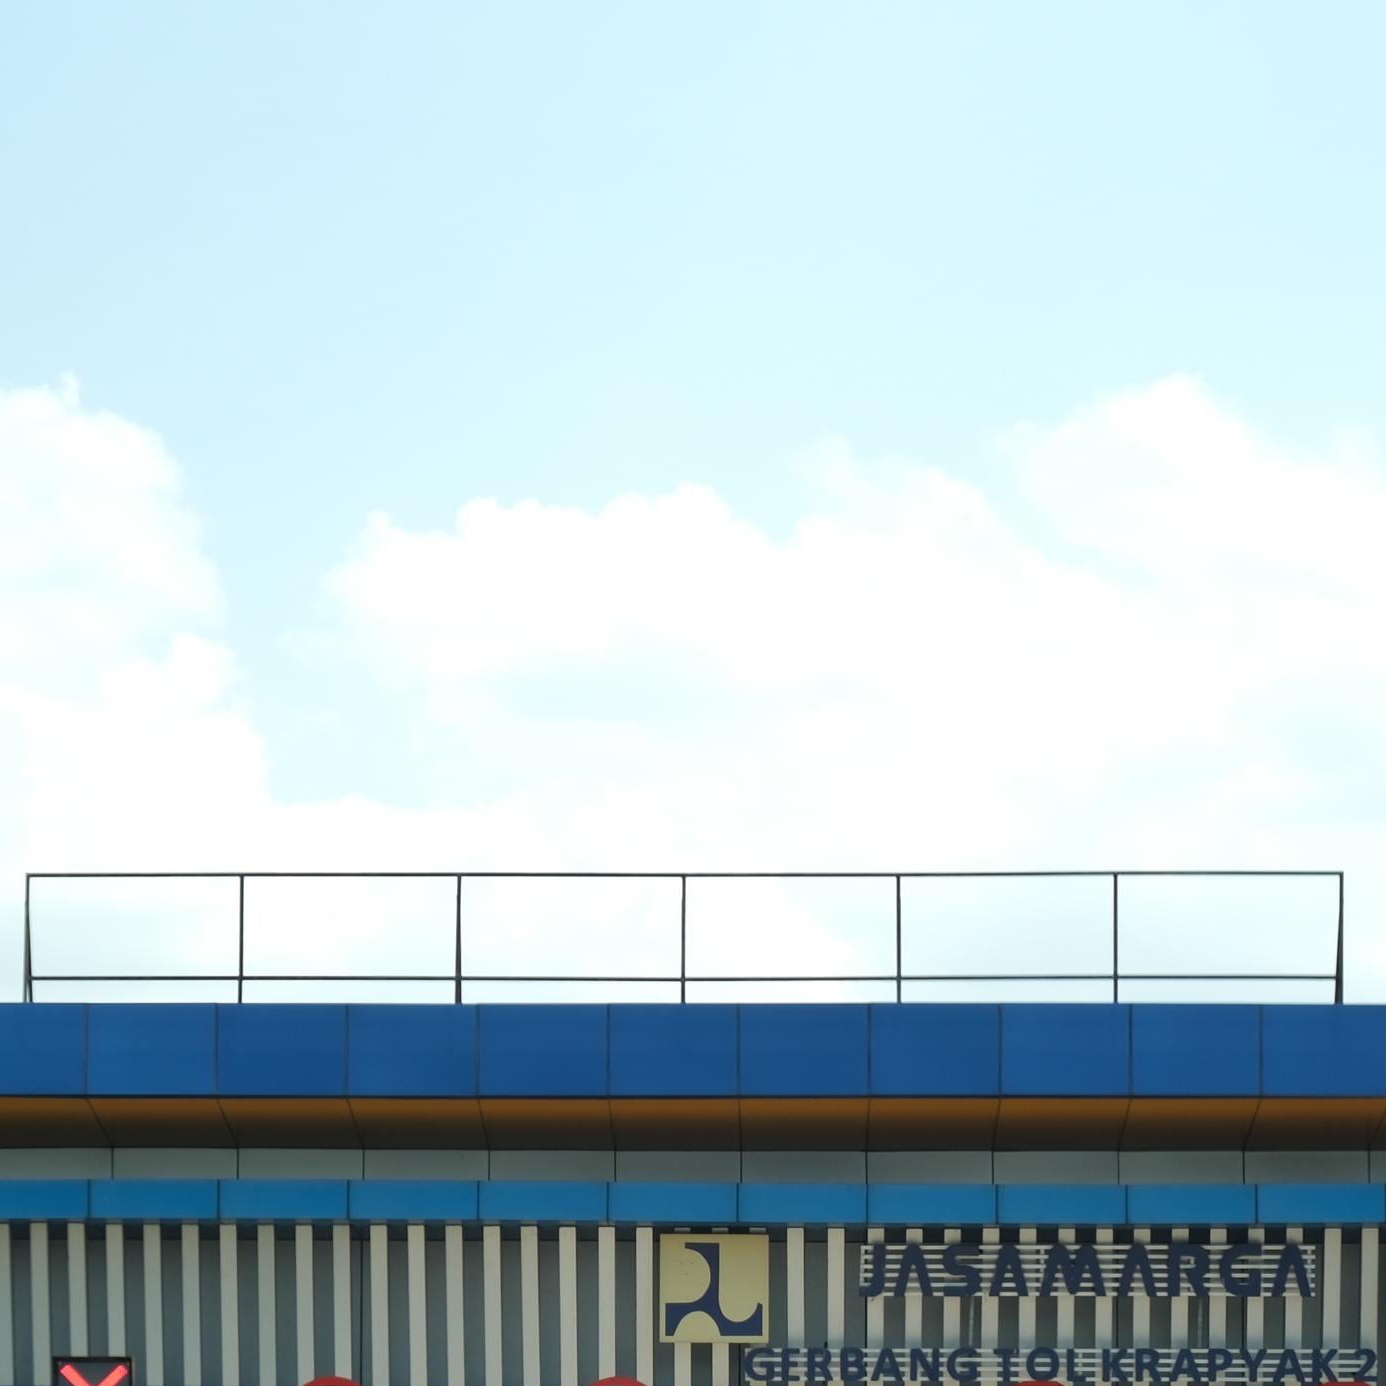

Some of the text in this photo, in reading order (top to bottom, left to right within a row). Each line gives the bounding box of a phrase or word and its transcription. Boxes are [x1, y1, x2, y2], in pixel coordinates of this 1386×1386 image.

[859, 1242, 1312, 1297] JASAMARGA
[743, 1347, 1378, 1382] GERBANG TOL KRAPYAK 2
